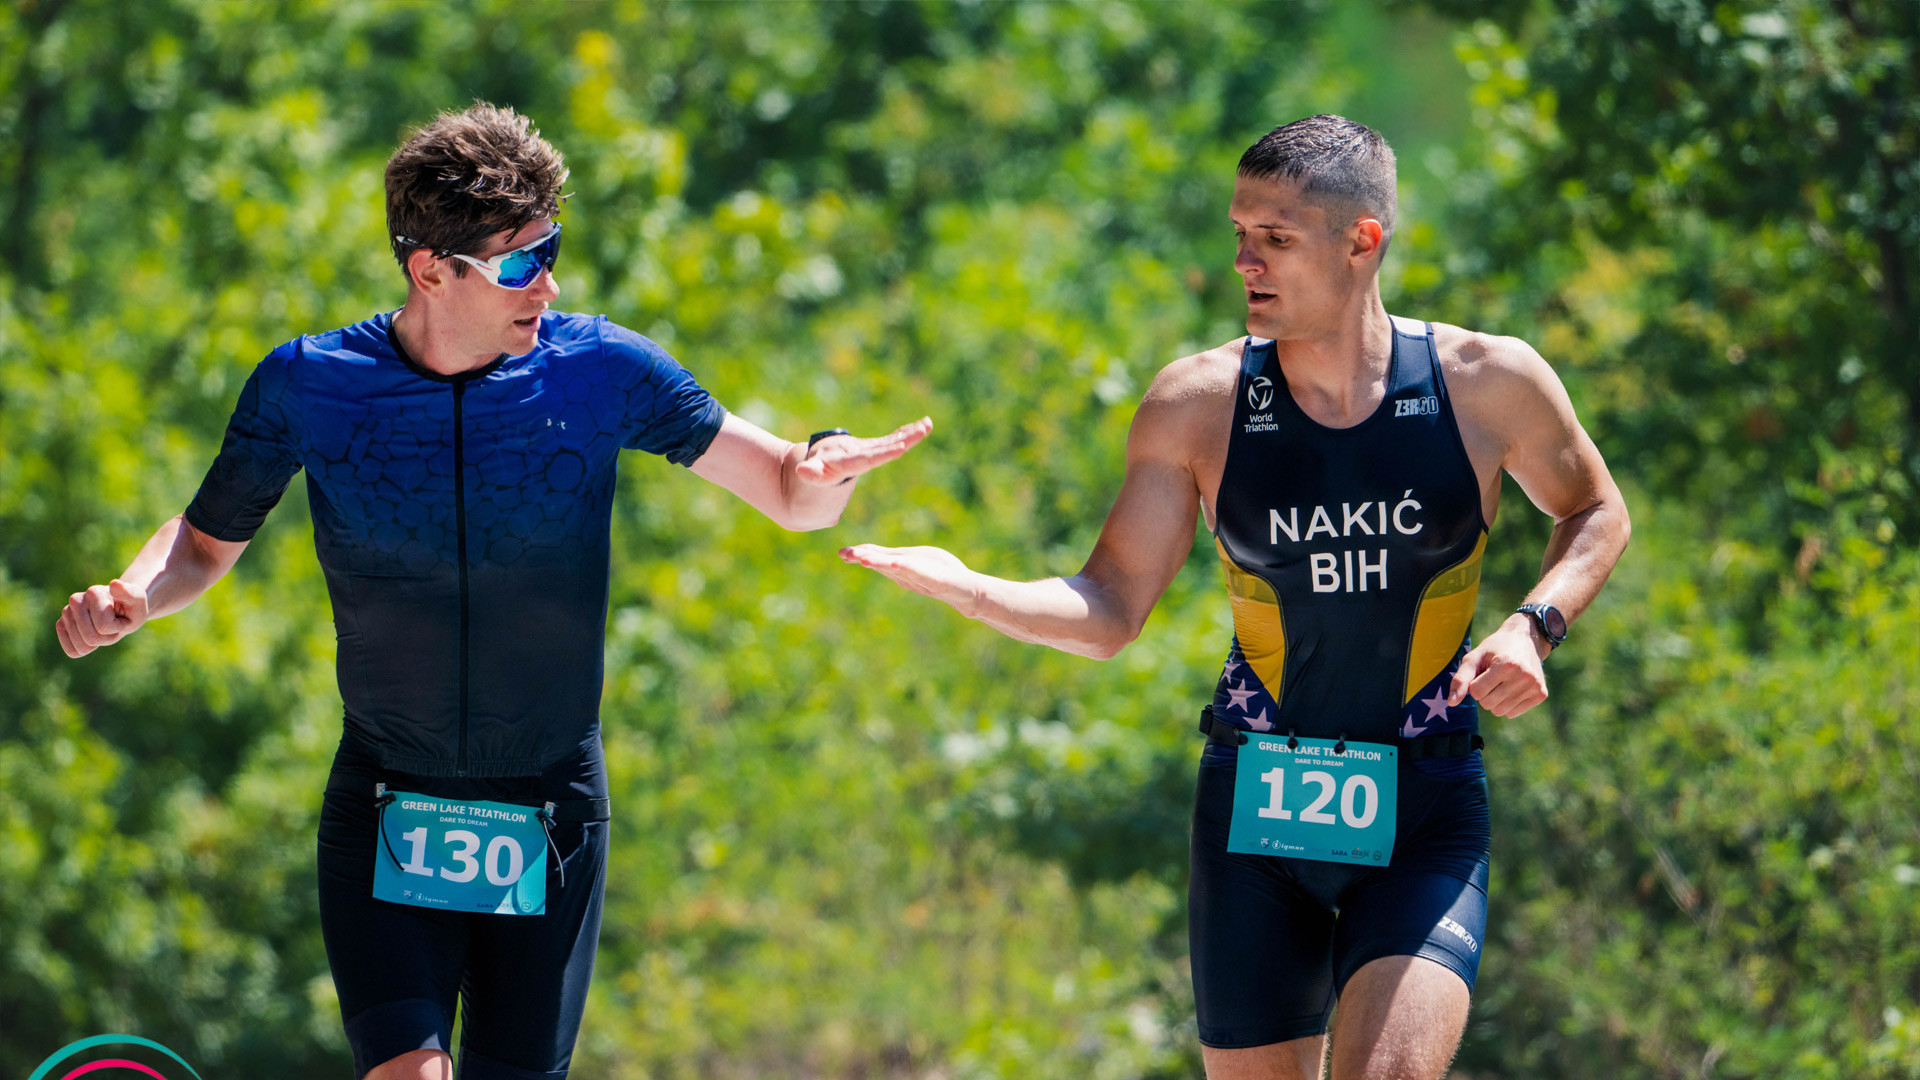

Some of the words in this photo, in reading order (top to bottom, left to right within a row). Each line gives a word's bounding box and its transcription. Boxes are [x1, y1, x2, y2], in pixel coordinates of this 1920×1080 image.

[1244, 423, 1279, 433] Triathlon
[1250, 413, 1273, 423] World
[1269, 489, 1424, 545] NAKIĆ
[1310, 549, 1388, 592] BIH
[1258, 741, 1292, 754] GREEN
[1294, 746, 1321, 756] LAKE
[1323, 747, 1381, 761] TRATHLON
[1294, 757, 1312, 765] DARE
[1258, 767, 1379, 829] 120
[401, 800, 437, 812] GREEN
[439, 804, 466, 815] LAKE
[468, 806, 527, 823] TRIATHLON
[439, 816, 456, 824] DARE
[467, 819, 488, 827] DREAM
[400, 826, 524, 886] 130
